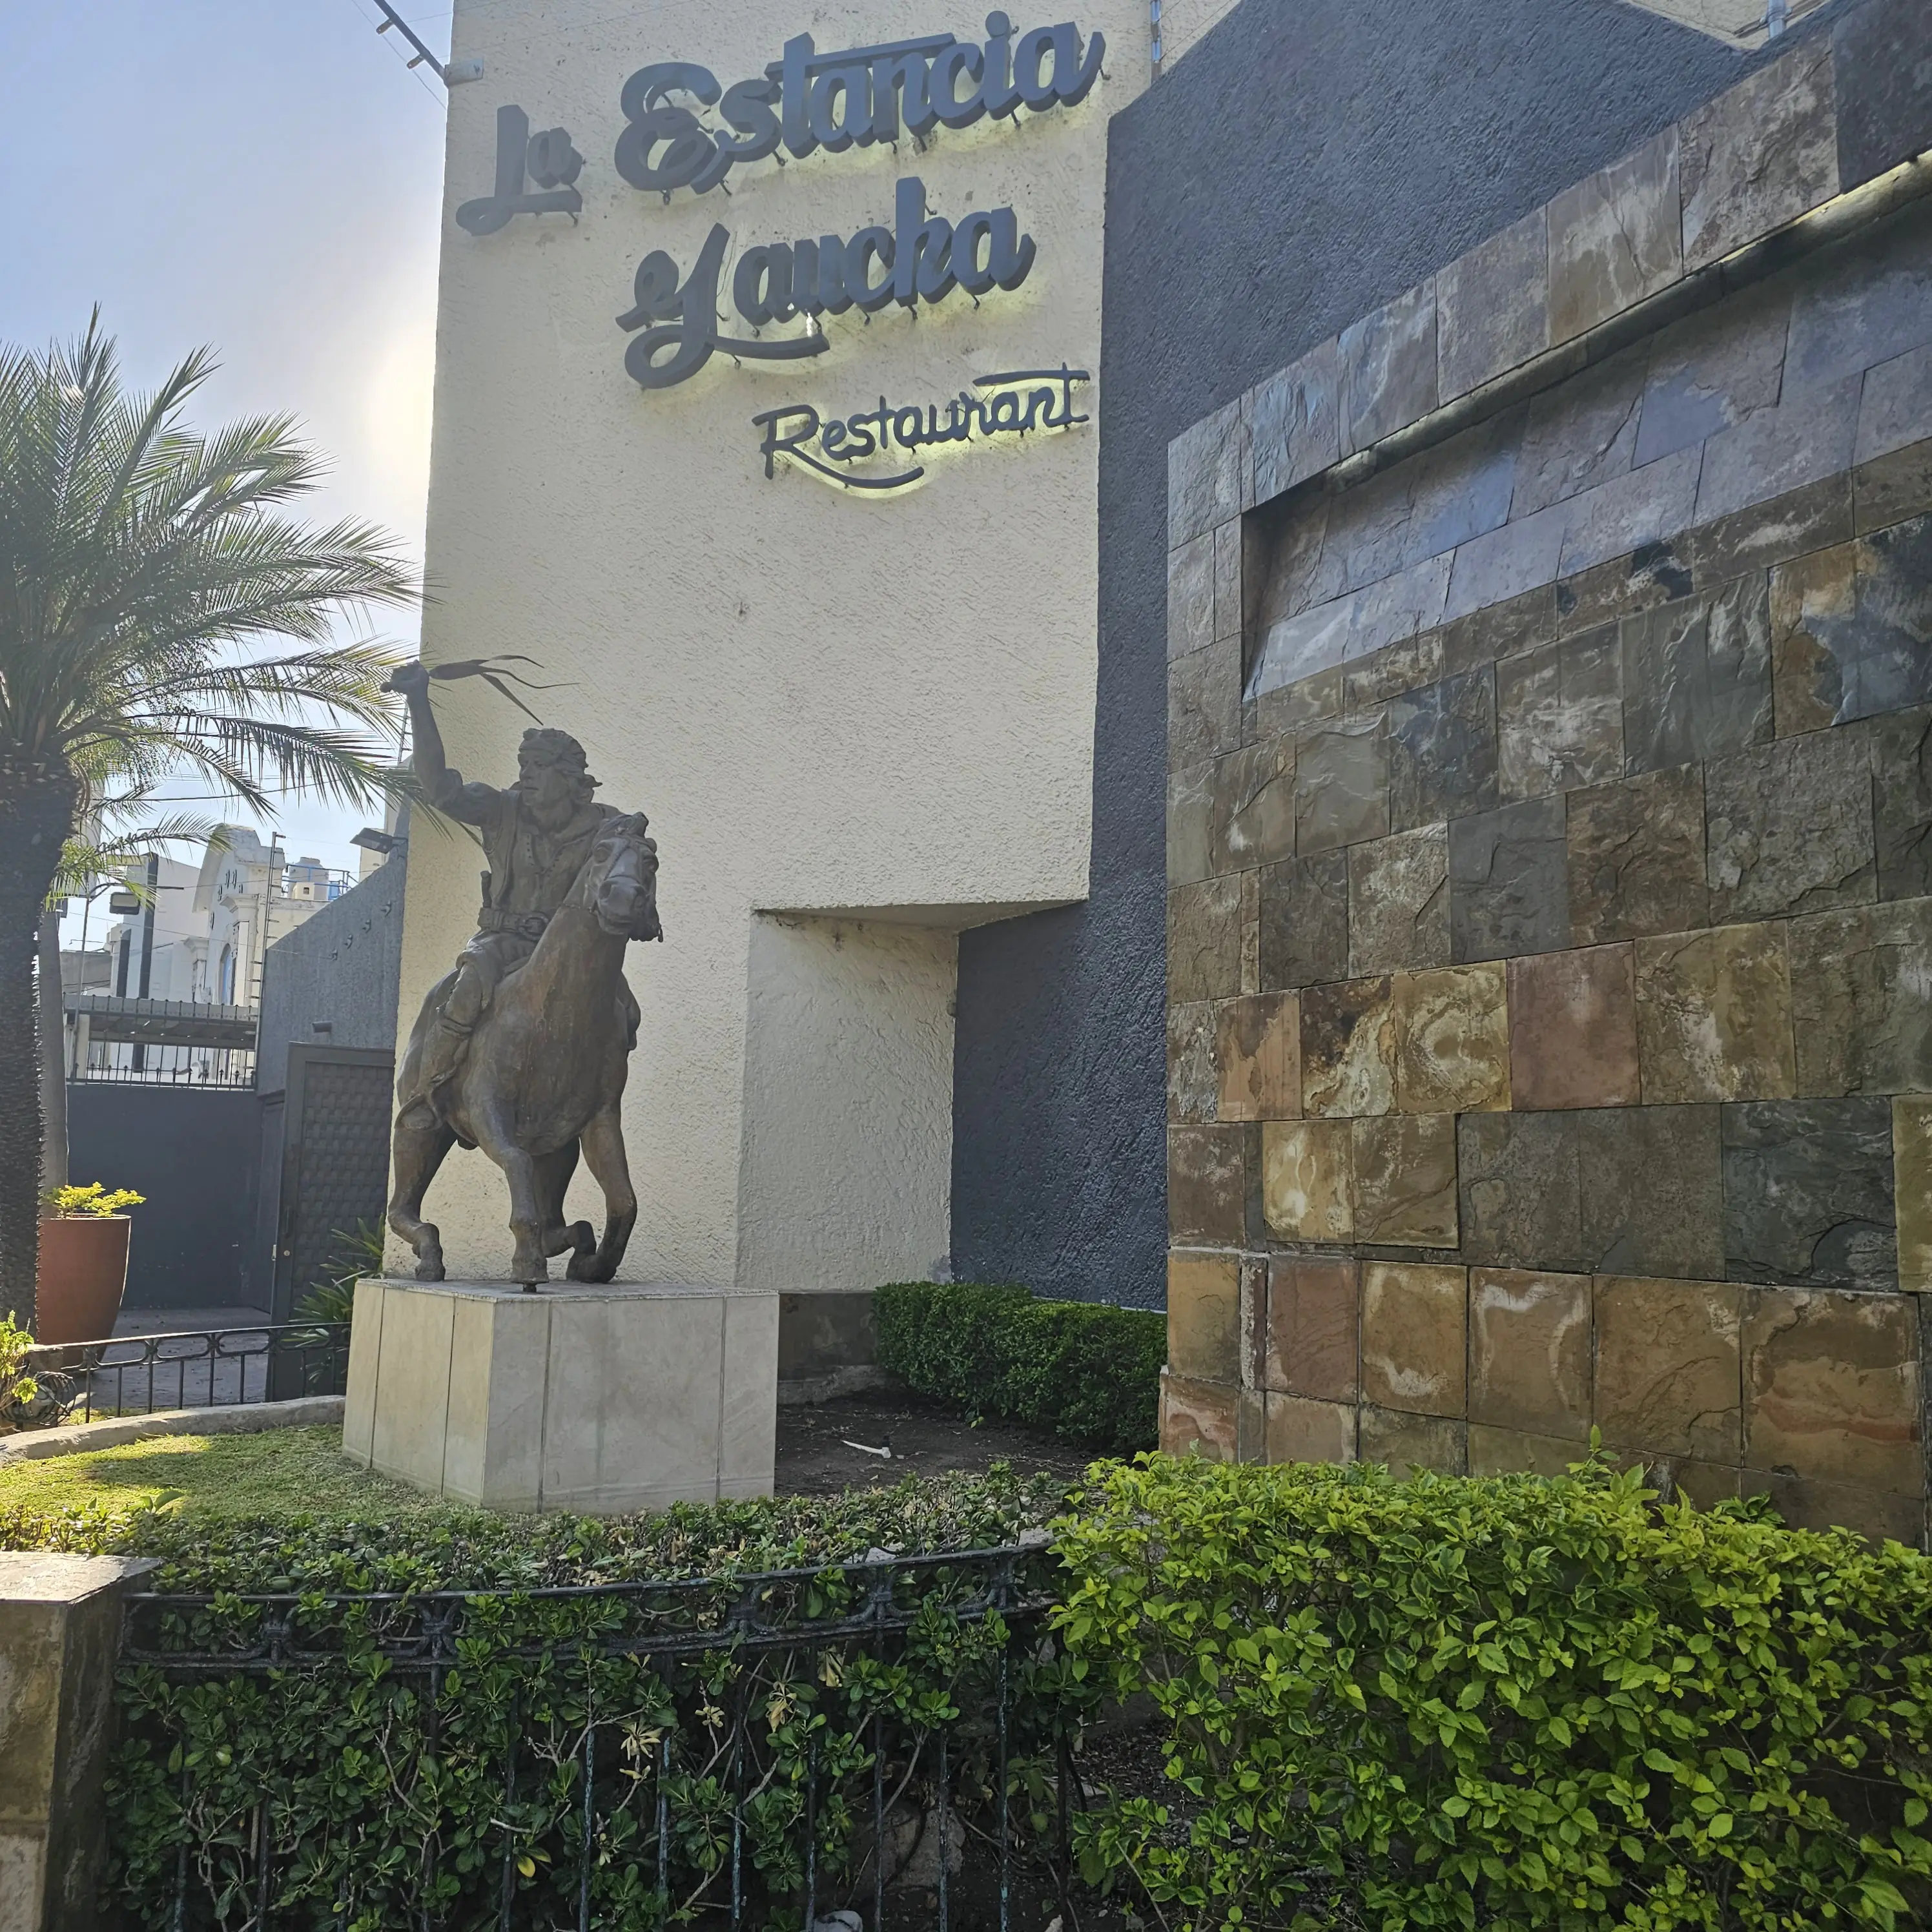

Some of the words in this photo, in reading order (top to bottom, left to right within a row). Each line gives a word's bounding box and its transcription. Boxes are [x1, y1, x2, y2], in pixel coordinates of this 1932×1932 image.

[456, 105, 582, 236] La
[614, 10, 1105, 195] Estancia
[752, 364, 1090, 489] Restaurant
